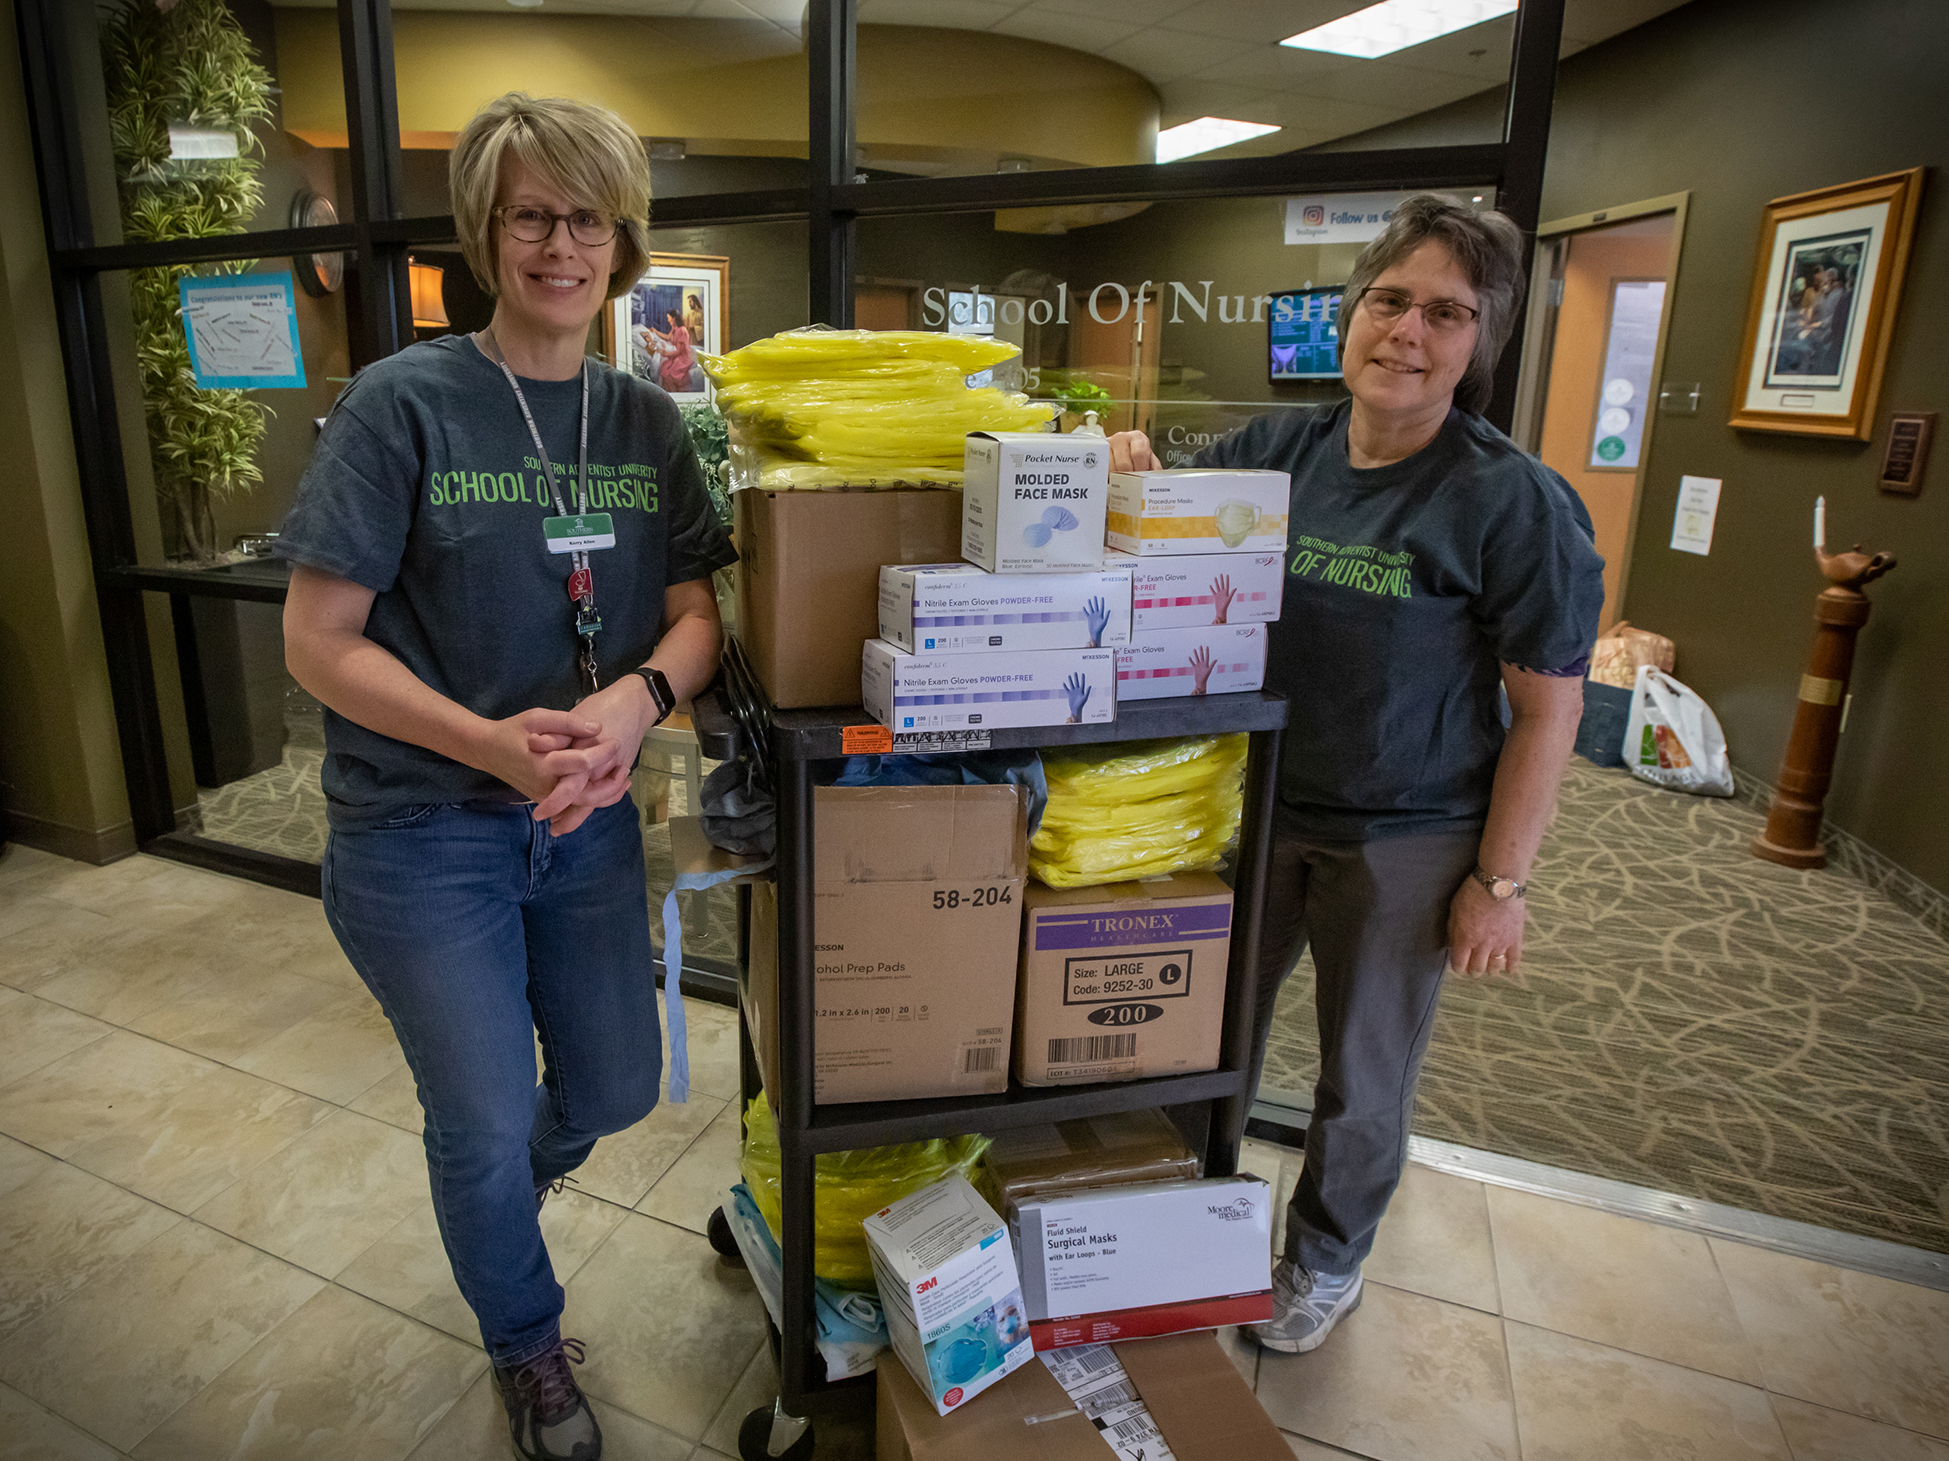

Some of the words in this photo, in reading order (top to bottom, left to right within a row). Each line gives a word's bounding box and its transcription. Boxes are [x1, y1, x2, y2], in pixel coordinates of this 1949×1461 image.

[1330, 212, 1364, 224] Follow
[1367, 214, 1378, 223] us
[923, 281, 1069, 326] School
[1088, 280, 1152, 325] Of
[1168, 280, 1344, 324] Nursin
[1024, 454, 1053, 463] Pocket
[1055, 454, 1080, 463] Nurse
[568, 463, 616, 477] ADENTIST
[1015, 474, 1070, 485] MOLDED
[430, 471, 531, 506] SCHOOL
[1014, 488, 1048, 500] FACE
[1052, 488, 1089, 500] MASK
[1297, 535, 1340, 555] SOUTHERN
[1165, 573, 1187, 581] Gloves
[1290, 550, 1327, 577] OF
[1319, 558, 1412, 599] NURSING
[1133, 584, 1157, 592] R-FREE
[924, 599, 947, 608] Nitrile
[948, 599, 970, 607] Exam
[971, 598, 999, 606] Gloves
[1000, 596, 1054, 605] POWDER-FREE
[1142, 645, 1165, 653] Gloves
[903, 679, 927, 687] Nitrile
[928, 678, 949, 686] Exam
[950, 677, 979, 685] Gloves
[980, 674, 1034, 683] POWDER-FREE
[932, 885, 1012, 910] 58-204
[1091, 931, 1173, 942] HEALTHCARE
[814, 944, 844, 952] ESSON
[816, 964, 844, 974] ohol
[846, 963, 875, 975] Prep
[877, 962, 906, 972] Pads
[1074, 968, 1098, 980] Size:
[1104, 962, 1144, 977] LARGE
[1166, 968, 1175, 981] L
[1073, 985, 1101, 995] Code:
[1103, 978, 1154, 994] 9252-30
[815, 1009, 827, 1017] 1.2
[846, 1008, 859, 1016] 2.6
[875, 1007, 890, 1015] 200
[899, 1006, 909, 1014] 20
[1103, 1005, 1148, 1025] 200
[977, 1037, 1002, 1045] 58-204
[877, 1208, 891, 1219] 3M
[1207, 1206, 1233, 1215] Moore
[1218, 1206, 1250, 1219] medical
[1047, 1229, 1064, 1237] Fluid
[1065, 1226, 1087, 1235] Shield
[1047, 1235, 1086, 1250] Surgical
[1089, 1233, 1118, 1245] Masks
[1077, 1251, 1096, 1259] Loops
[1102, 1248, 1117, 1256] Blue
[915, 1276, 938, 1295] 3M
[927, 1322, 951, 1340] 1860S
[1134, 1430, 1148, 1439] 374
